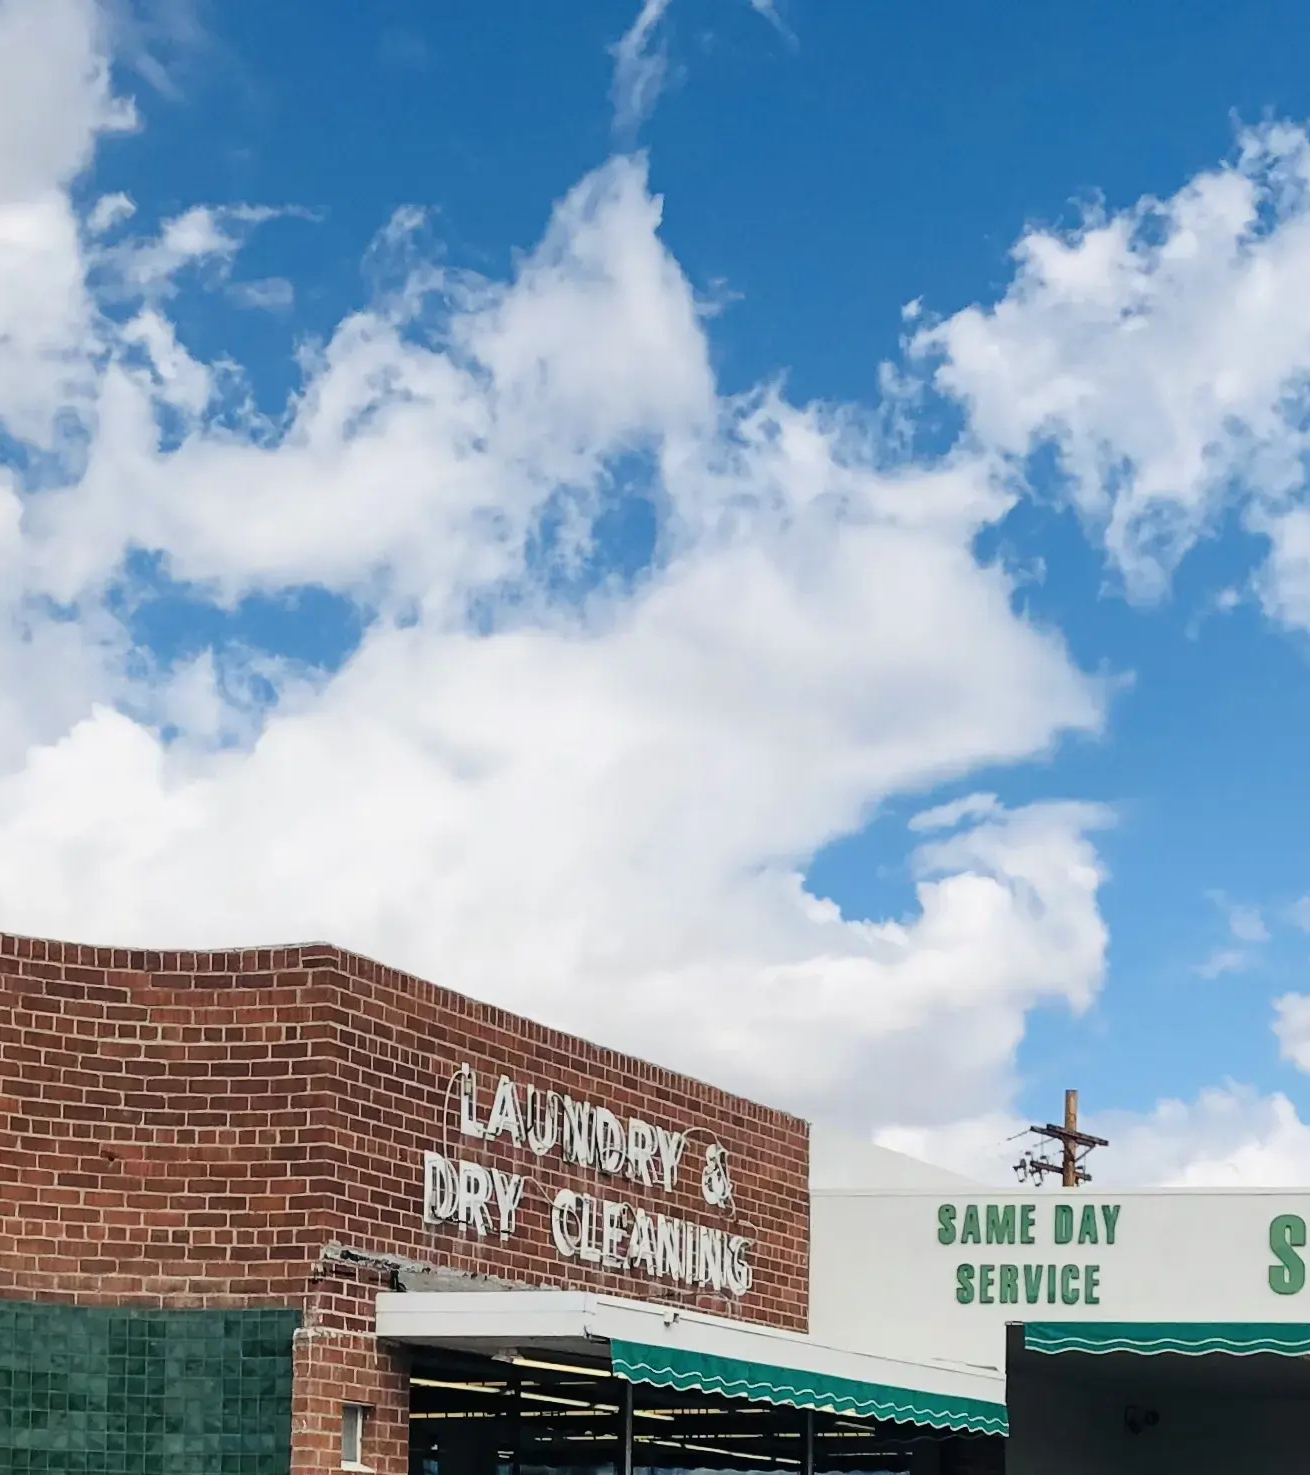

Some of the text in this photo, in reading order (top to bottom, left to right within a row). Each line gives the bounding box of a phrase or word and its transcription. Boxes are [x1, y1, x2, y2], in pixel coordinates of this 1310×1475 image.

[459, 1062, 732, 1208] LAUNDRY &
[423, 1149, 753, 1297] DRY CLEANING
[937, 1203, 1121, 1245] SAME DAY
[956, 1263, 1100, 1305] SERVICE
